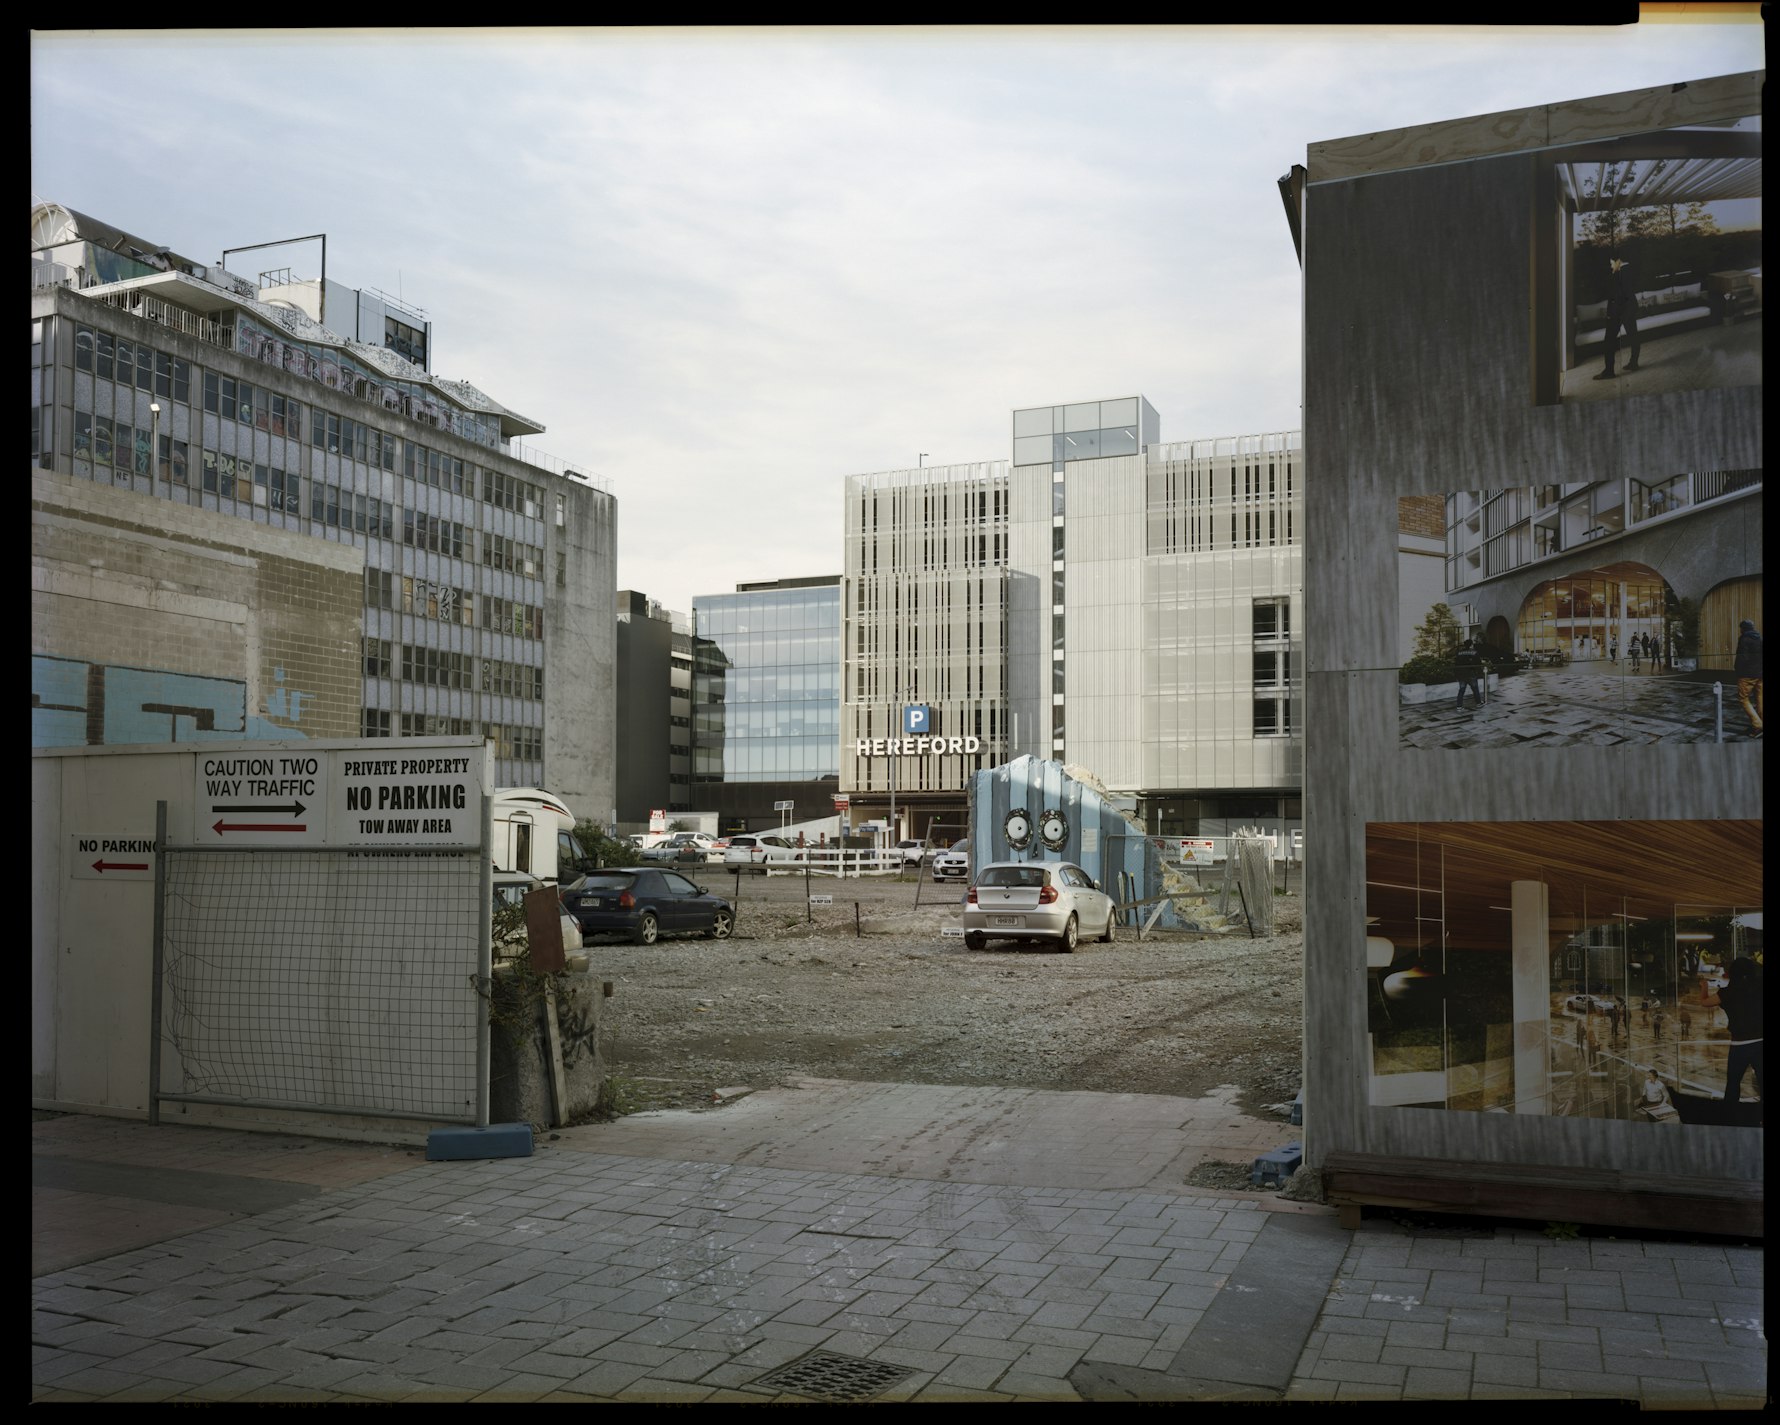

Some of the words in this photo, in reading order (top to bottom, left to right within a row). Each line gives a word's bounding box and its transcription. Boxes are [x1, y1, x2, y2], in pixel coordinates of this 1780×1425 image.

[910, 711, 924, 728] P
[856, 736, 980, 756] HEREFORD
[204, 759, 274, 776] CAUTION
[279, 758, 318, 775] TWO
[344, 760, 398, 776] PRIVATE
[400, 758, 470, 775] PROPERTY
[206, 780, 242, 796] WAY
[247, 779, 315, 796] TRAFFIC
[346, 786, 372, 811] NO
[378, 784, 466, 810] PARKING
[359, 819, 385, 834] TOW
[387, 819, 419, 834] AWAY
[422, 818, 452, 834] AREA
[79, 839, 98, 852] NO
